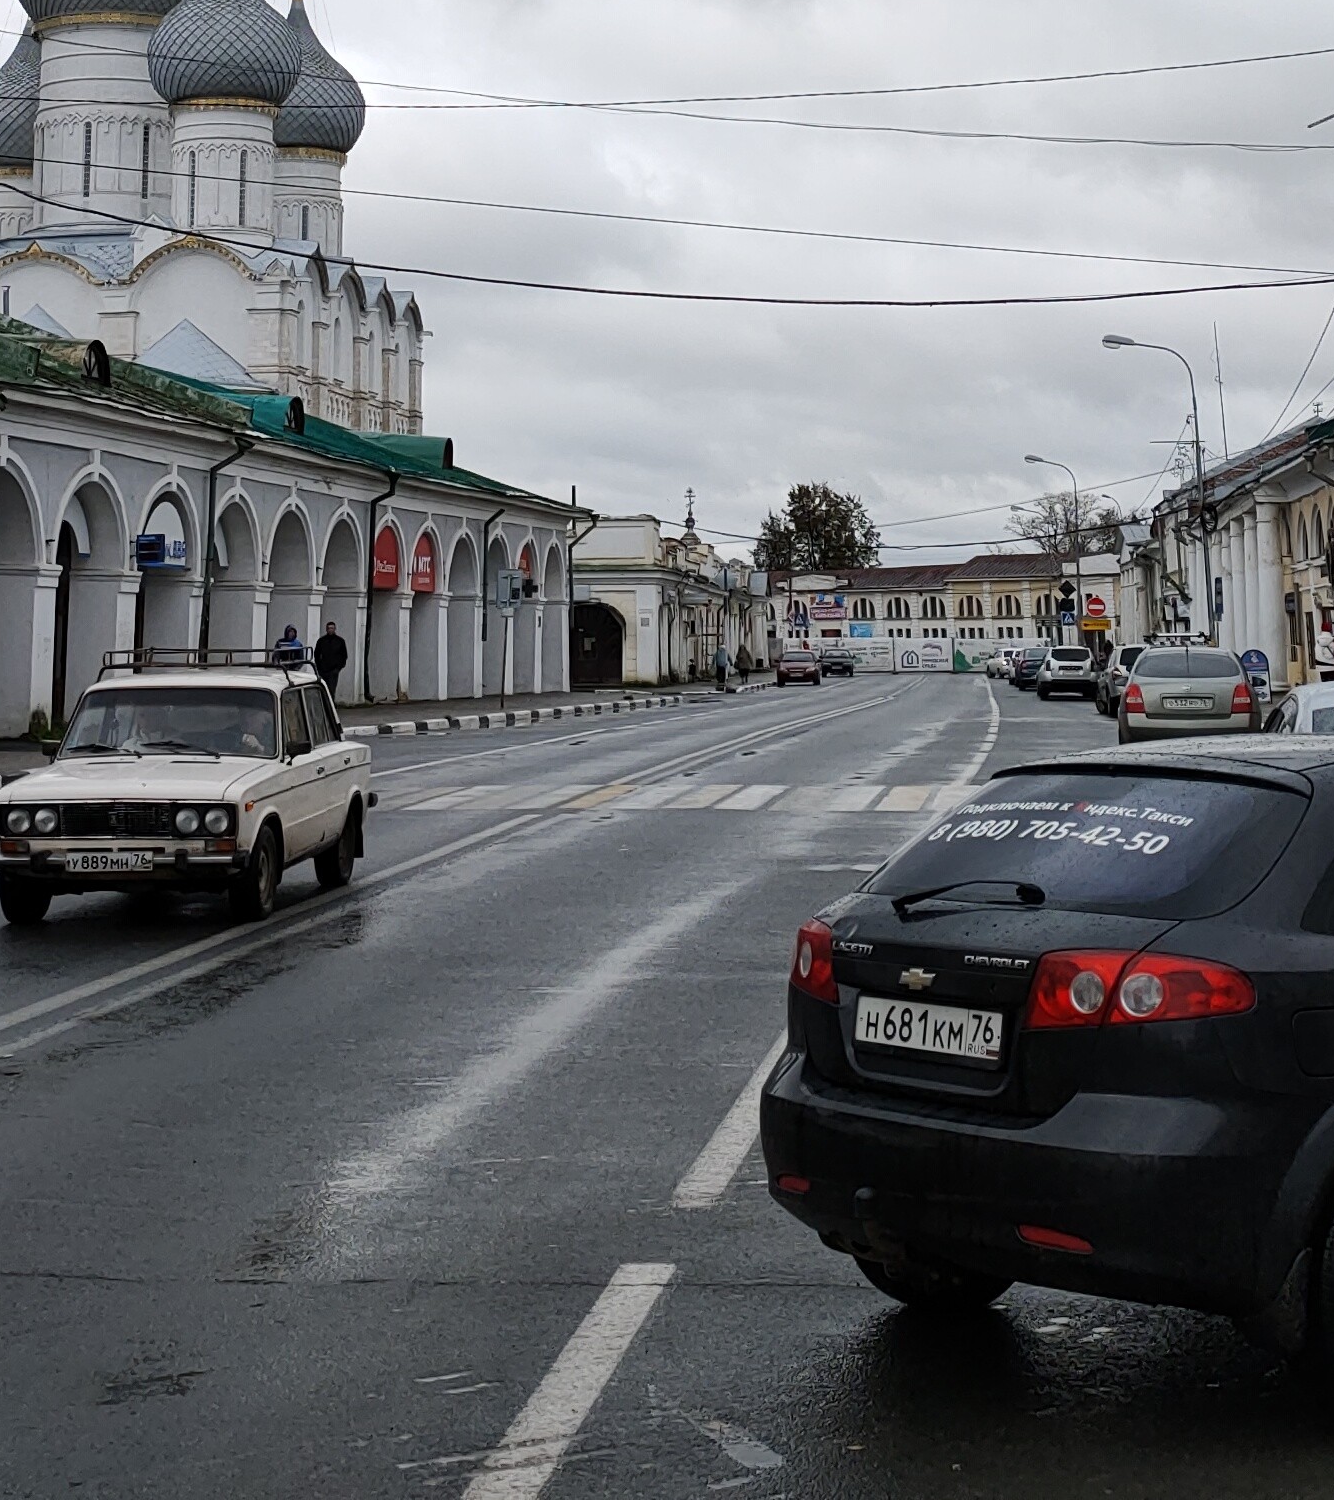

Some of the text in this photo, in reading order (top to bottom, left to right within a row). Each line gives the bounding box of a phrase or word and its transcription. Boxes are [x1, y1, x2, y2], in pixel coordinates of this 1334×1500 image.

[927, 819, 1170, 855] 8 (980) 705-42-50
[71, 853, 148, 870] У889МН 76
[832, 940, 874, 955] LACETTI
[964, 955, 1030, 970] CHEVROLET
[866, 1005, 994, 1050] Н681КМ 76
[968, 1043, 986, 1055] RUS
